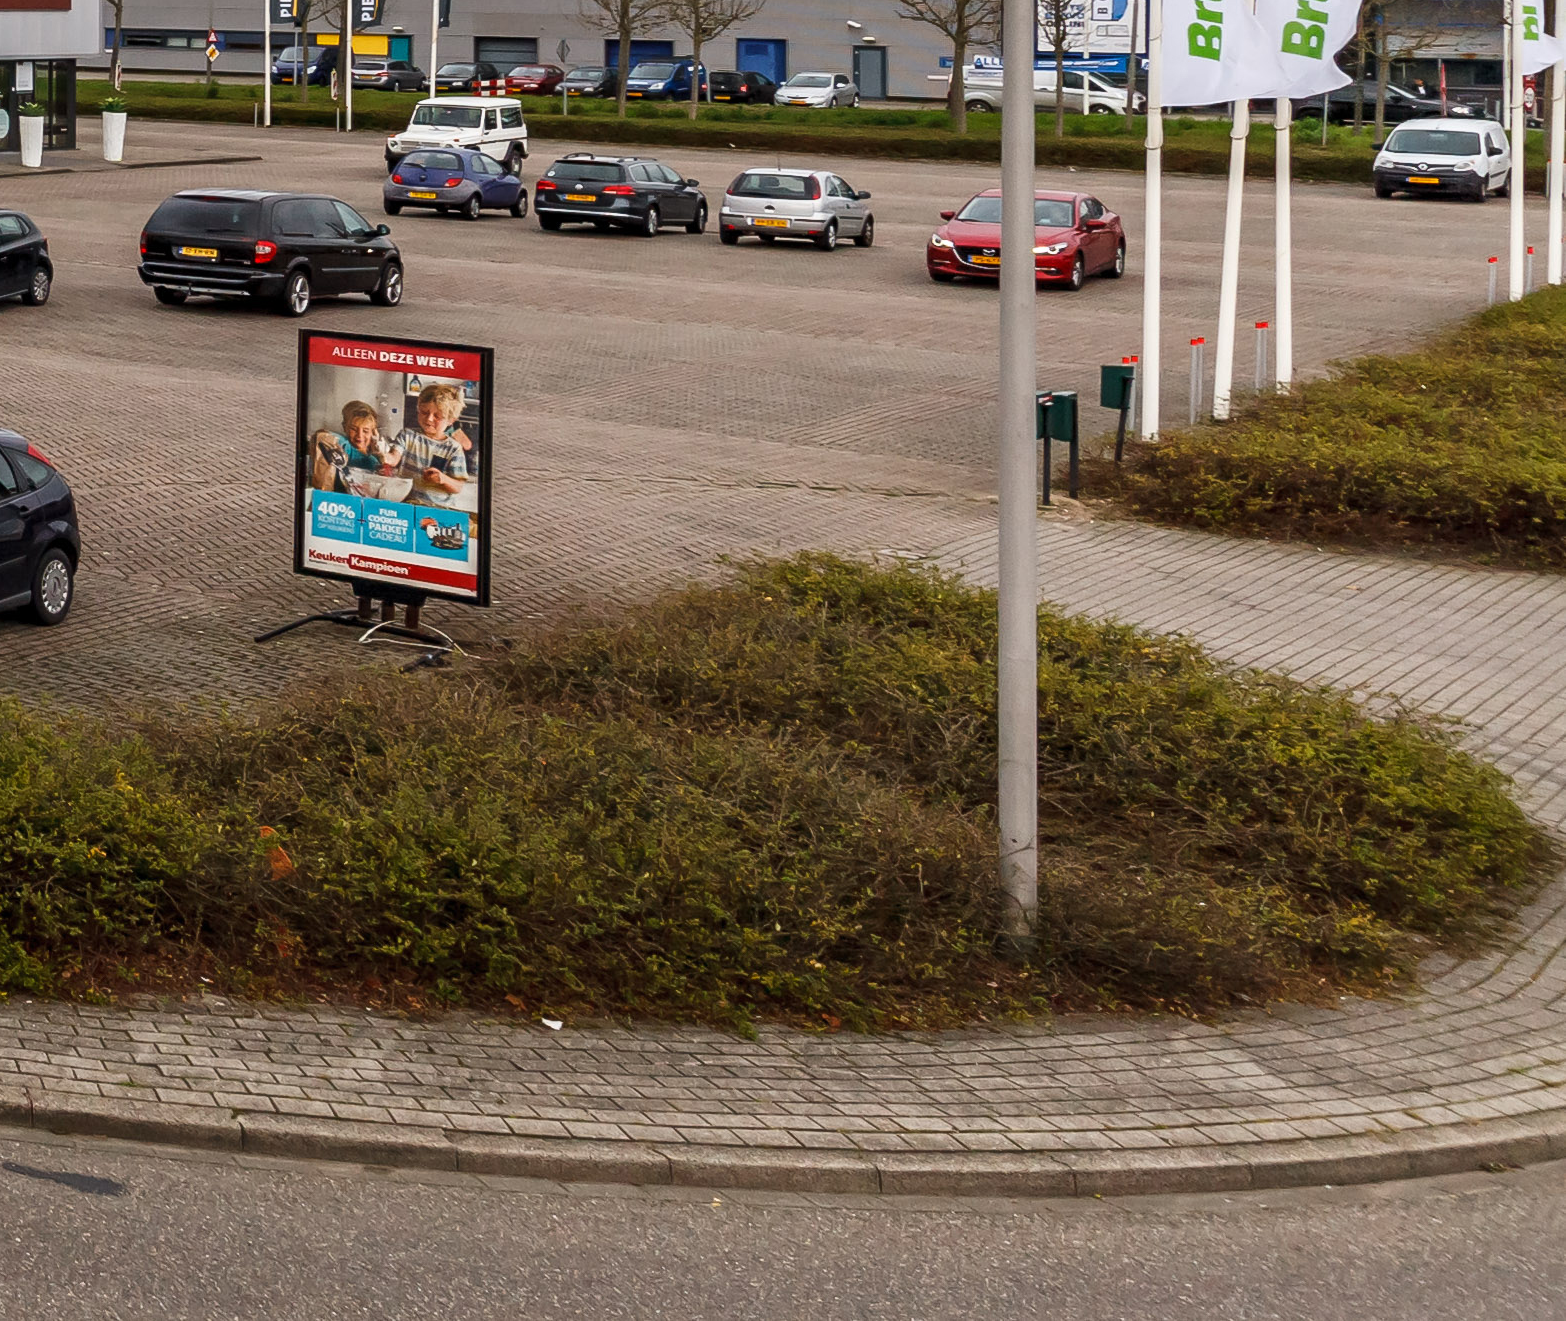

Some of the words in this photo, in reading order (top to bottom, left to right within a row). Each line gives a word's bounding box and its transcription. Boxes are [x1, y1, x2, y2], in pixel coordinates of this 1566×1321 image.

[332, 346, 376, 361] ALLEEN
[379, 351, 415, 366] DEZE
[416, 355, 456, 370] WEEK
[317, 501, 356, 519] 40%
[308, 549, 348, 566] Keuken
[350, 556, 410, 576] Kampioen
